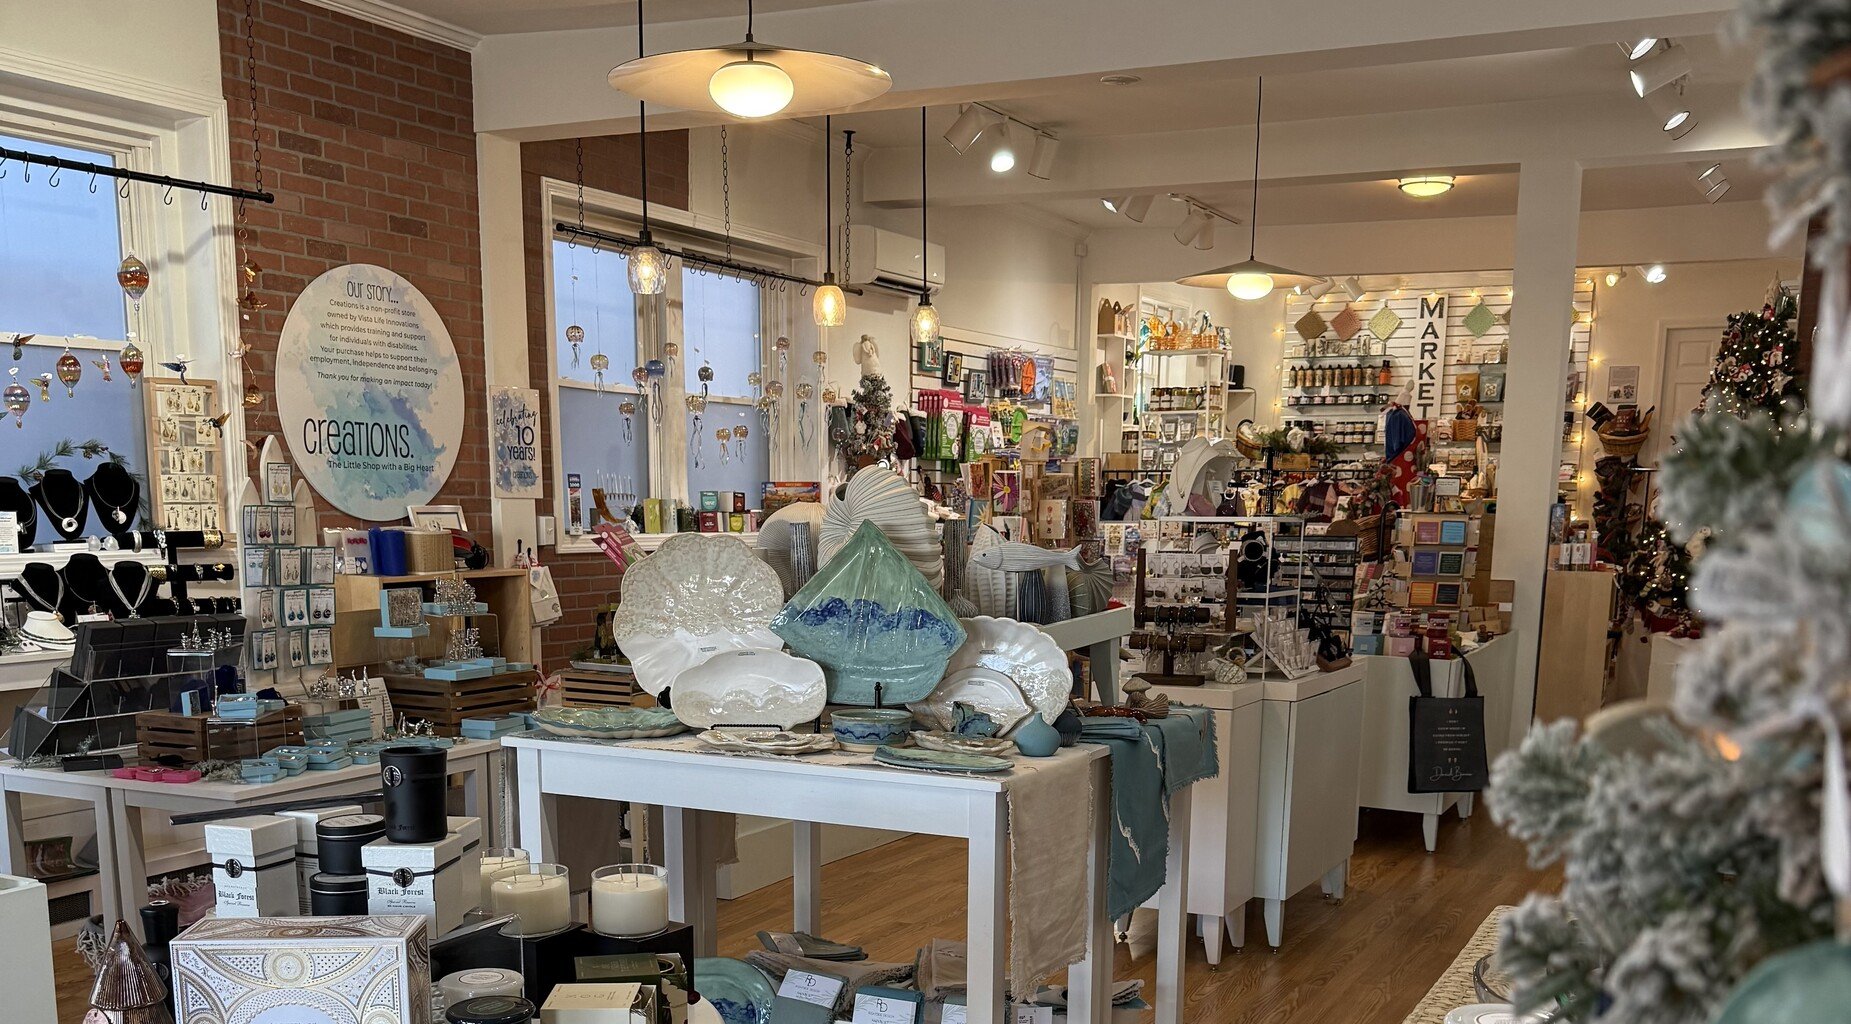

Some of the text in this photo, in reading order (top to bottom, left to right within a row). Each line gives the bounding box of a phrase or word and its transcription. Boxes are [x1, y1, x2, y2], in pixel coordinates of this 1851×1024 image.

[329, 299, 358, 309] Creations
[371, 305, 400, 315] non-profit
[401, 309, 416, 318] store
[327, 311, 420, 330] owned by Vista Life Innovations
[320, 322, 426, 341] which provides training and support
[340, 335, 372, 346] individuals
[372, 339, 387, 347] with
[320, 345, 335, 353] Your
[336, 348, 364, 357] purchase
[365, 350, 382, 359] helps
[390, 353, 413, 362] support
[413, 355, 428, 363] their
[1417, 297, 1445, 419] MARKET
[352, 359, 396, 370] independence
[396, 363, 408, 371] and
[317, 371, 337, 380] Thank
[337, 373, 350, 382] you
[350, 374, 359, 382] for
[360, 375, 382, 385] making
[393, 379, 414, 388] impact
[414, 380, 433, 390] today!
[496, 403, 538, 427] celebrating
[515, 425, 535, 446] 10
[328, 460, 342, 469] The
[343, 461, 361, 470] Little
[362, 461, 381, 471] Shop
[381, 462, 397, 471] with
[403, 463, 415, 473] Big
[416, 464, 435, 473] Heart
[218, 890, 235, 899] Black
[377, 887, 424, 897] Black Forest
